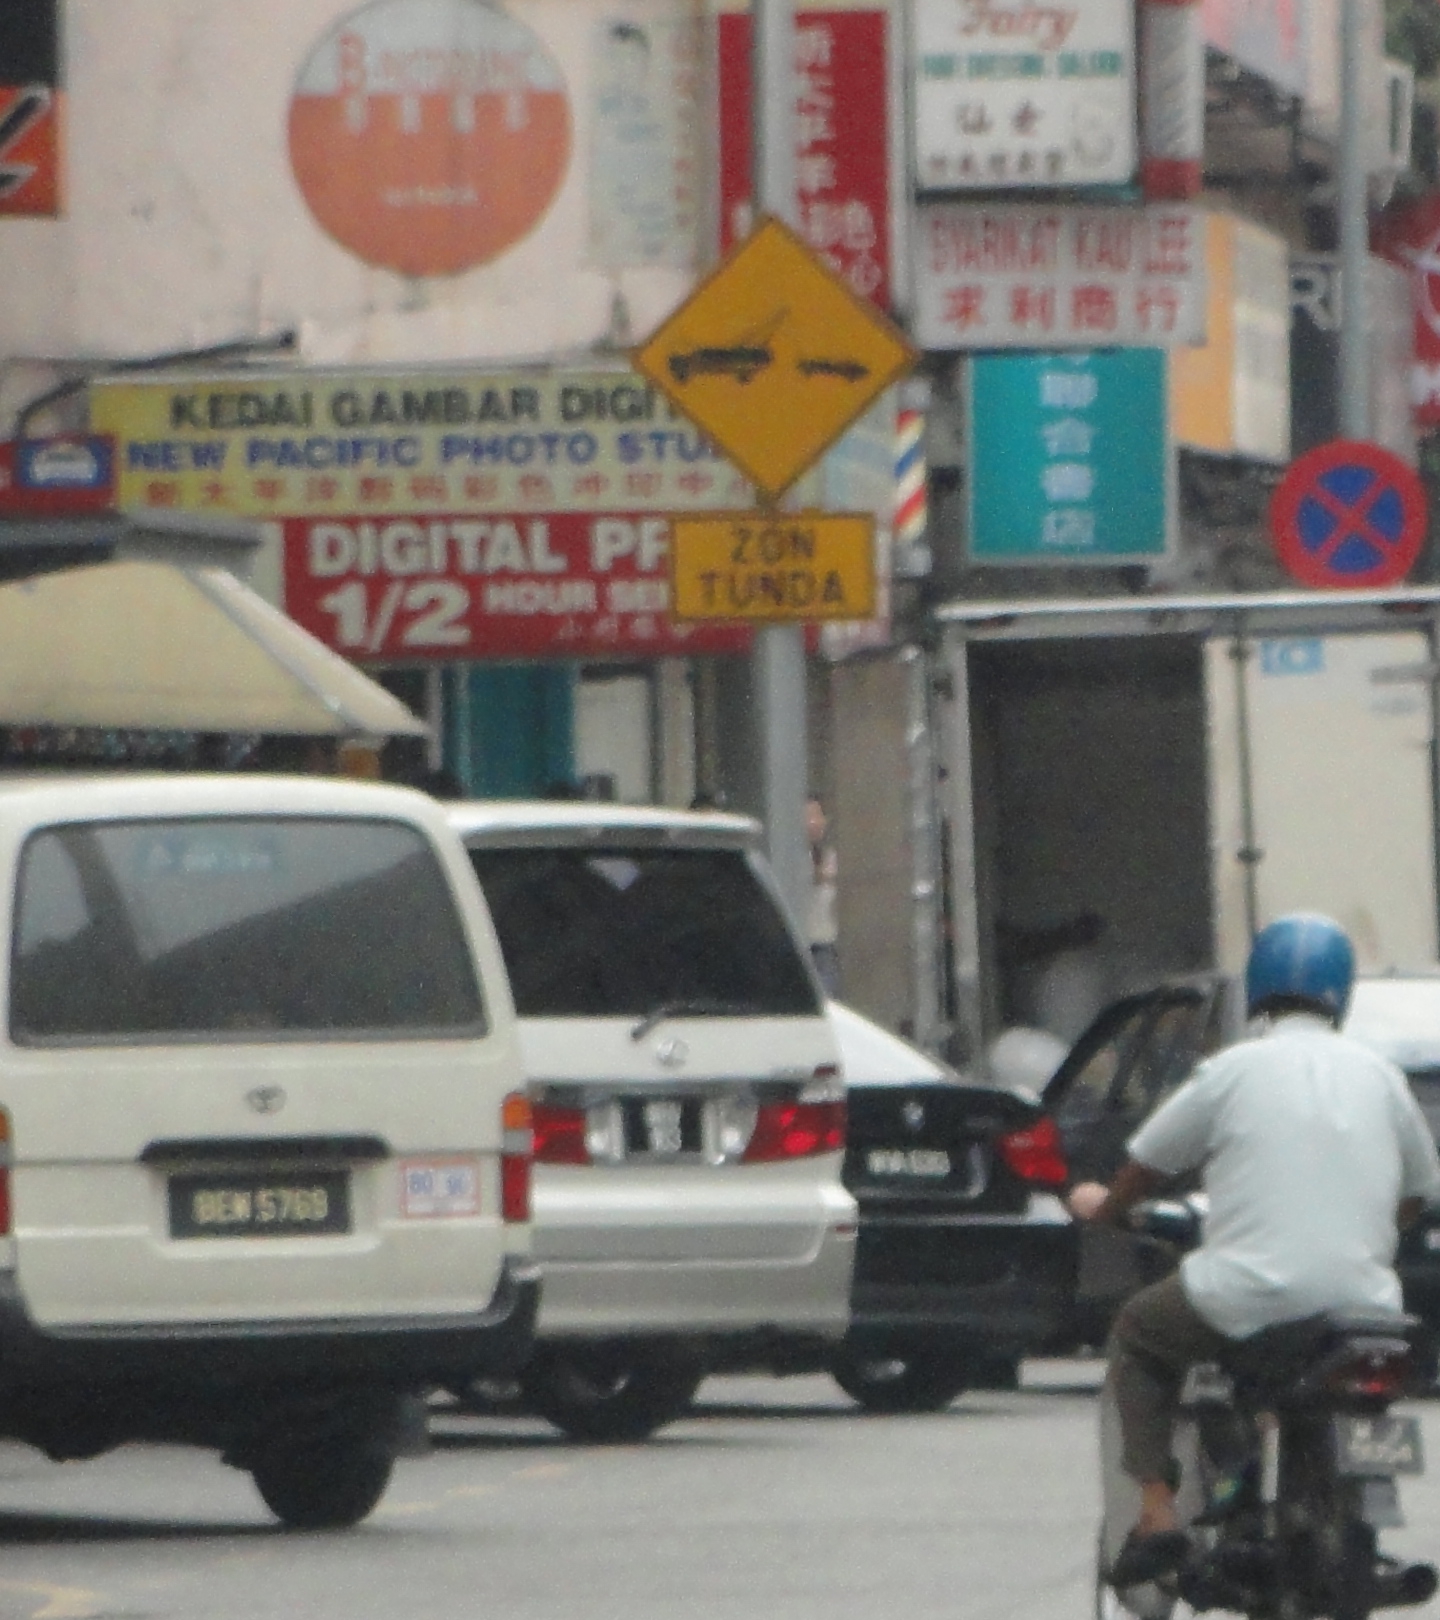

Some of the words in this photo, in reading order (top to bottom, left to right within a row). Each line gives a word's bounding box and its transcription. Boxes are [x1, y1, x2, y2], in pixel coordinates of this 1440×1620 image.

[171, 389, 314, 430] KEDAI
[330, 385, 543, 428] GAMBAR
[128, 439, 228, 471] NEW
[247, 434, 420, 469] PACIFIC
[440, 431, 599, 465] PHOTO
[309, 519, 567, 578] DIGITAL
[729, 526, 816, 563] ZON
[697, 568, 845, 608] TUNDA
[322, 578, 471, 653] 1/2
